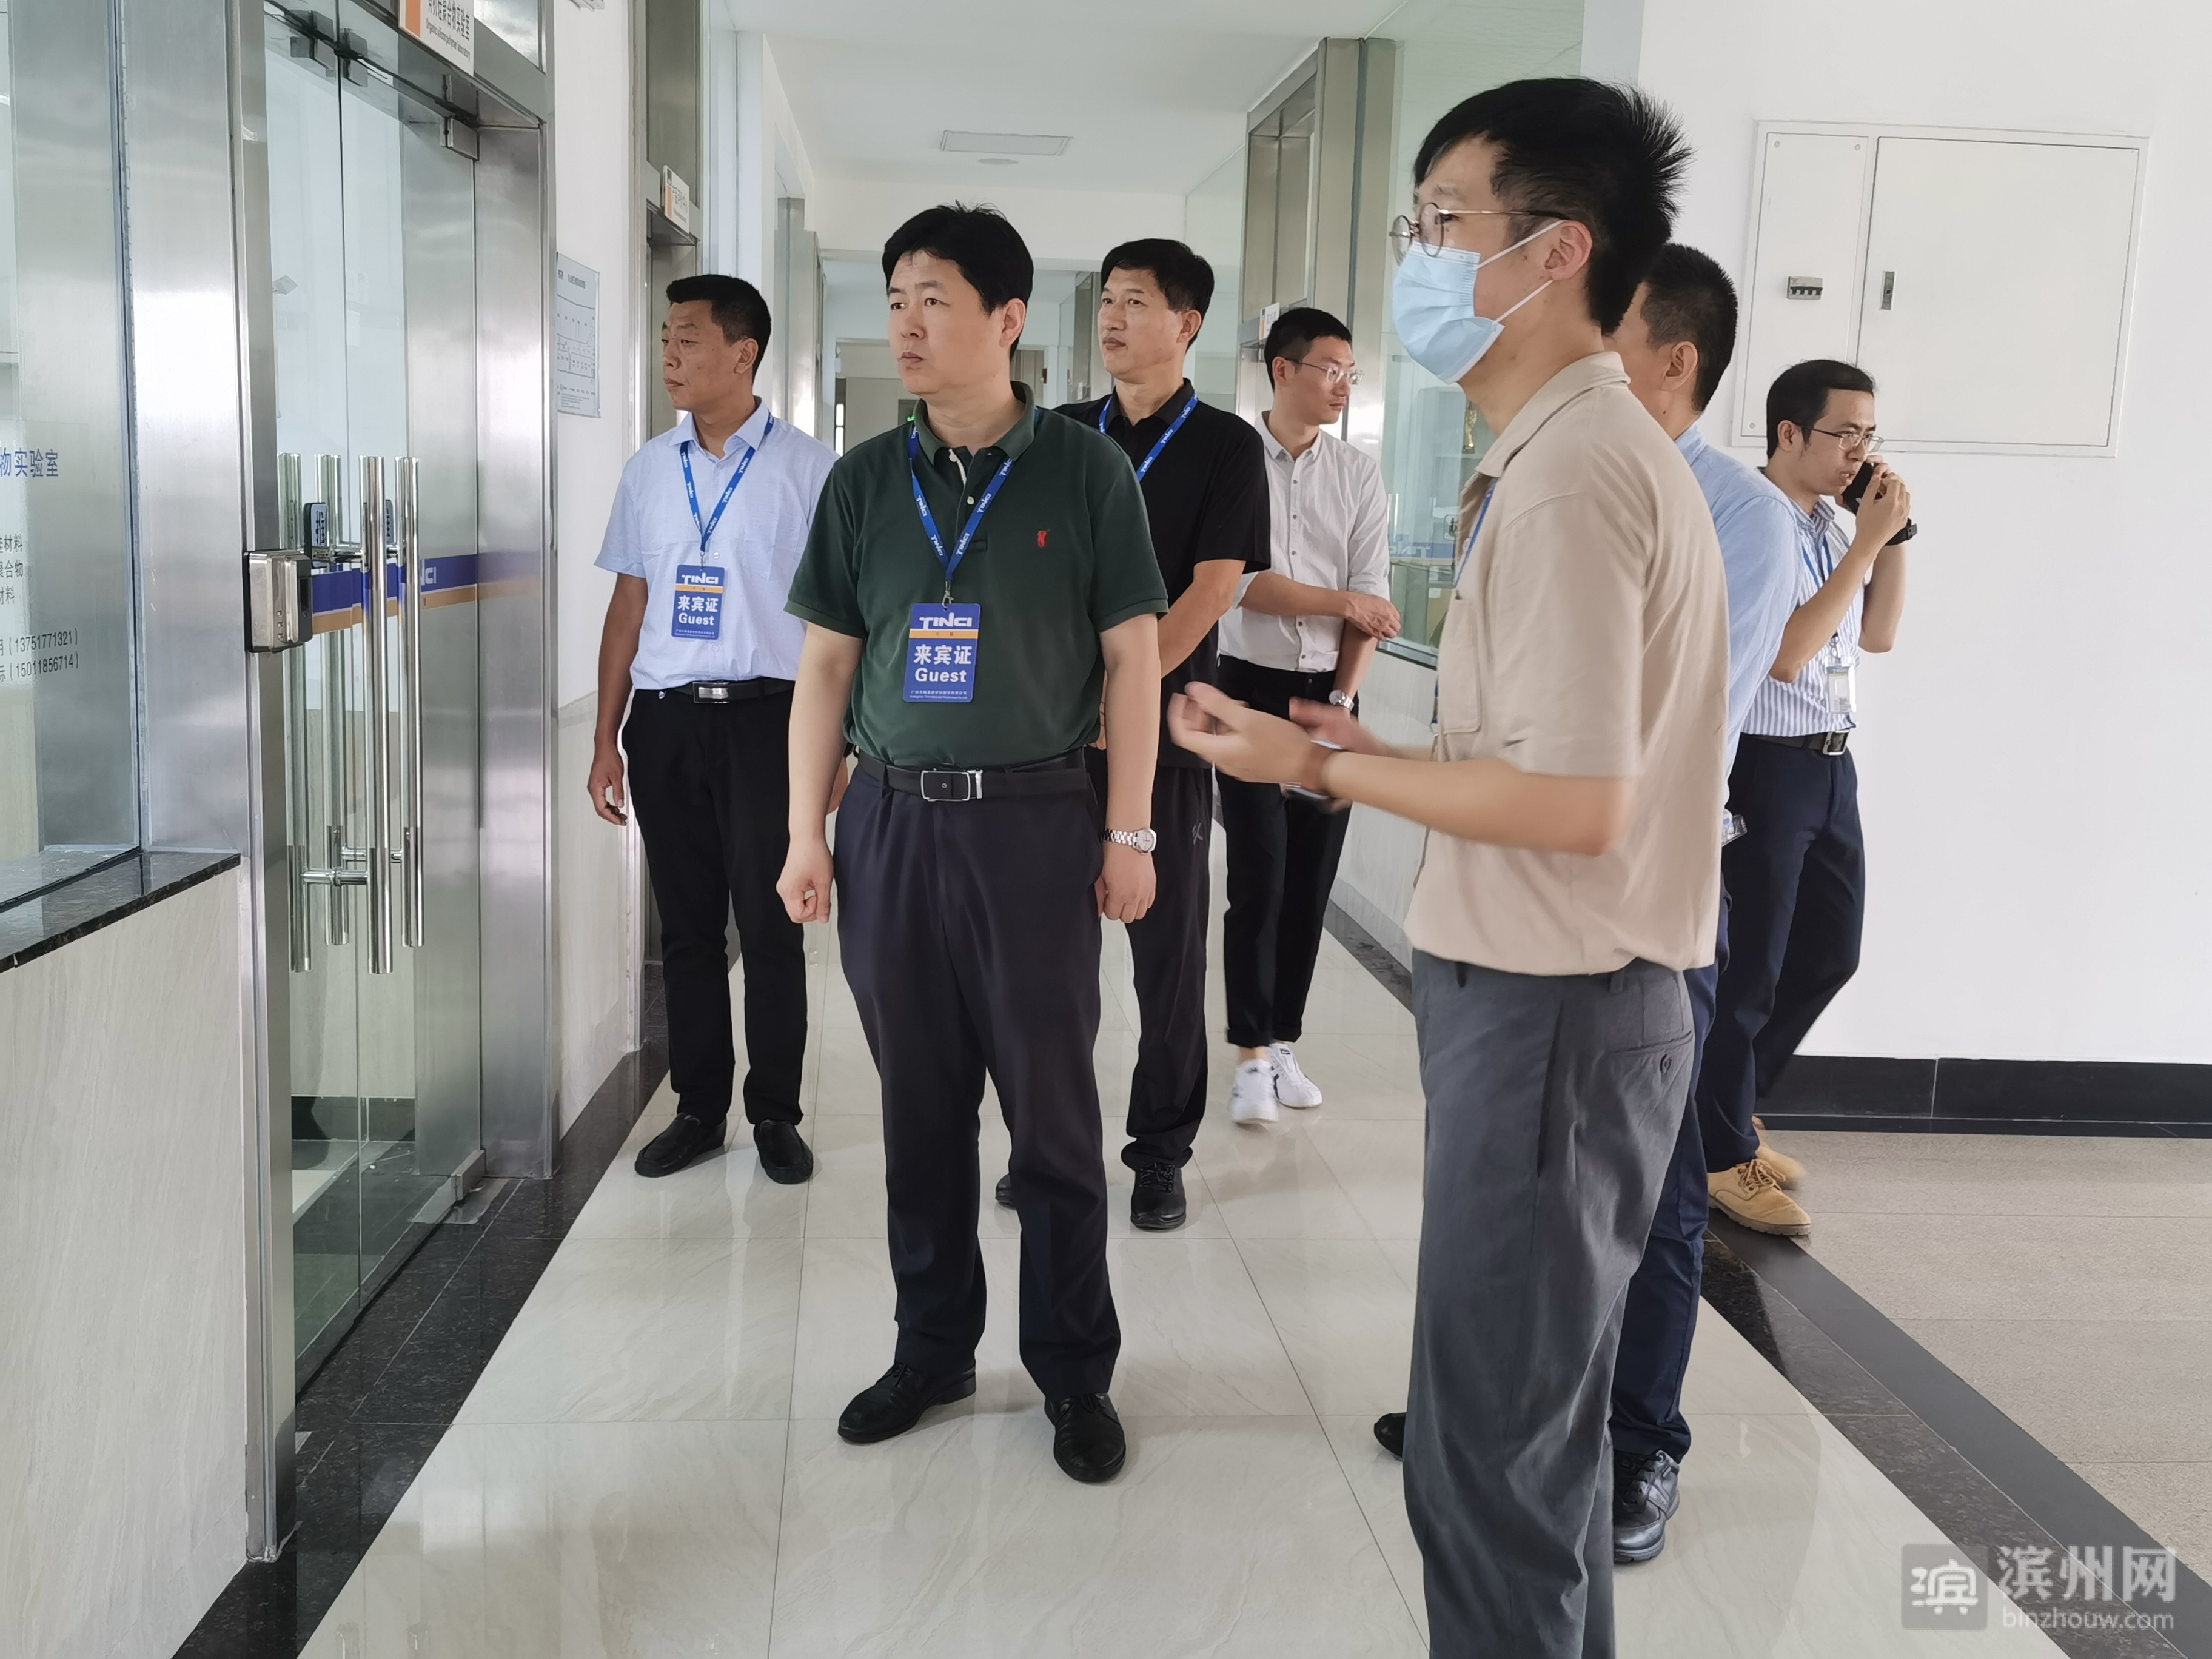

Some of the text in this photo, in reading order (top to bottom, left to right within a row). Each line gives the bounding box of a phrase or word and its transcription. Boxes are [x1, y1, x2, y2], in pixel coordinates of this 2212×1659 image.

[0, 448, 59, 478] 物实验室
[999, 458, 1013, 476] TINC
[916, 495, 928, 517] TINCI
[977, 493, 991, 514] TINCI
[930, 534, 943, 557] TINCI
[956, 532, 970, 556] TINCI
[681, 572, 719, 585] TINCI
[677, 595, 719, 612] 来宾证
[679, 612, 714, 626] Guest
[919, 612, 973, 629] TINCI
[913, 644, 973, 665] 来宾证
[914, 668, 967, 682] Guest
